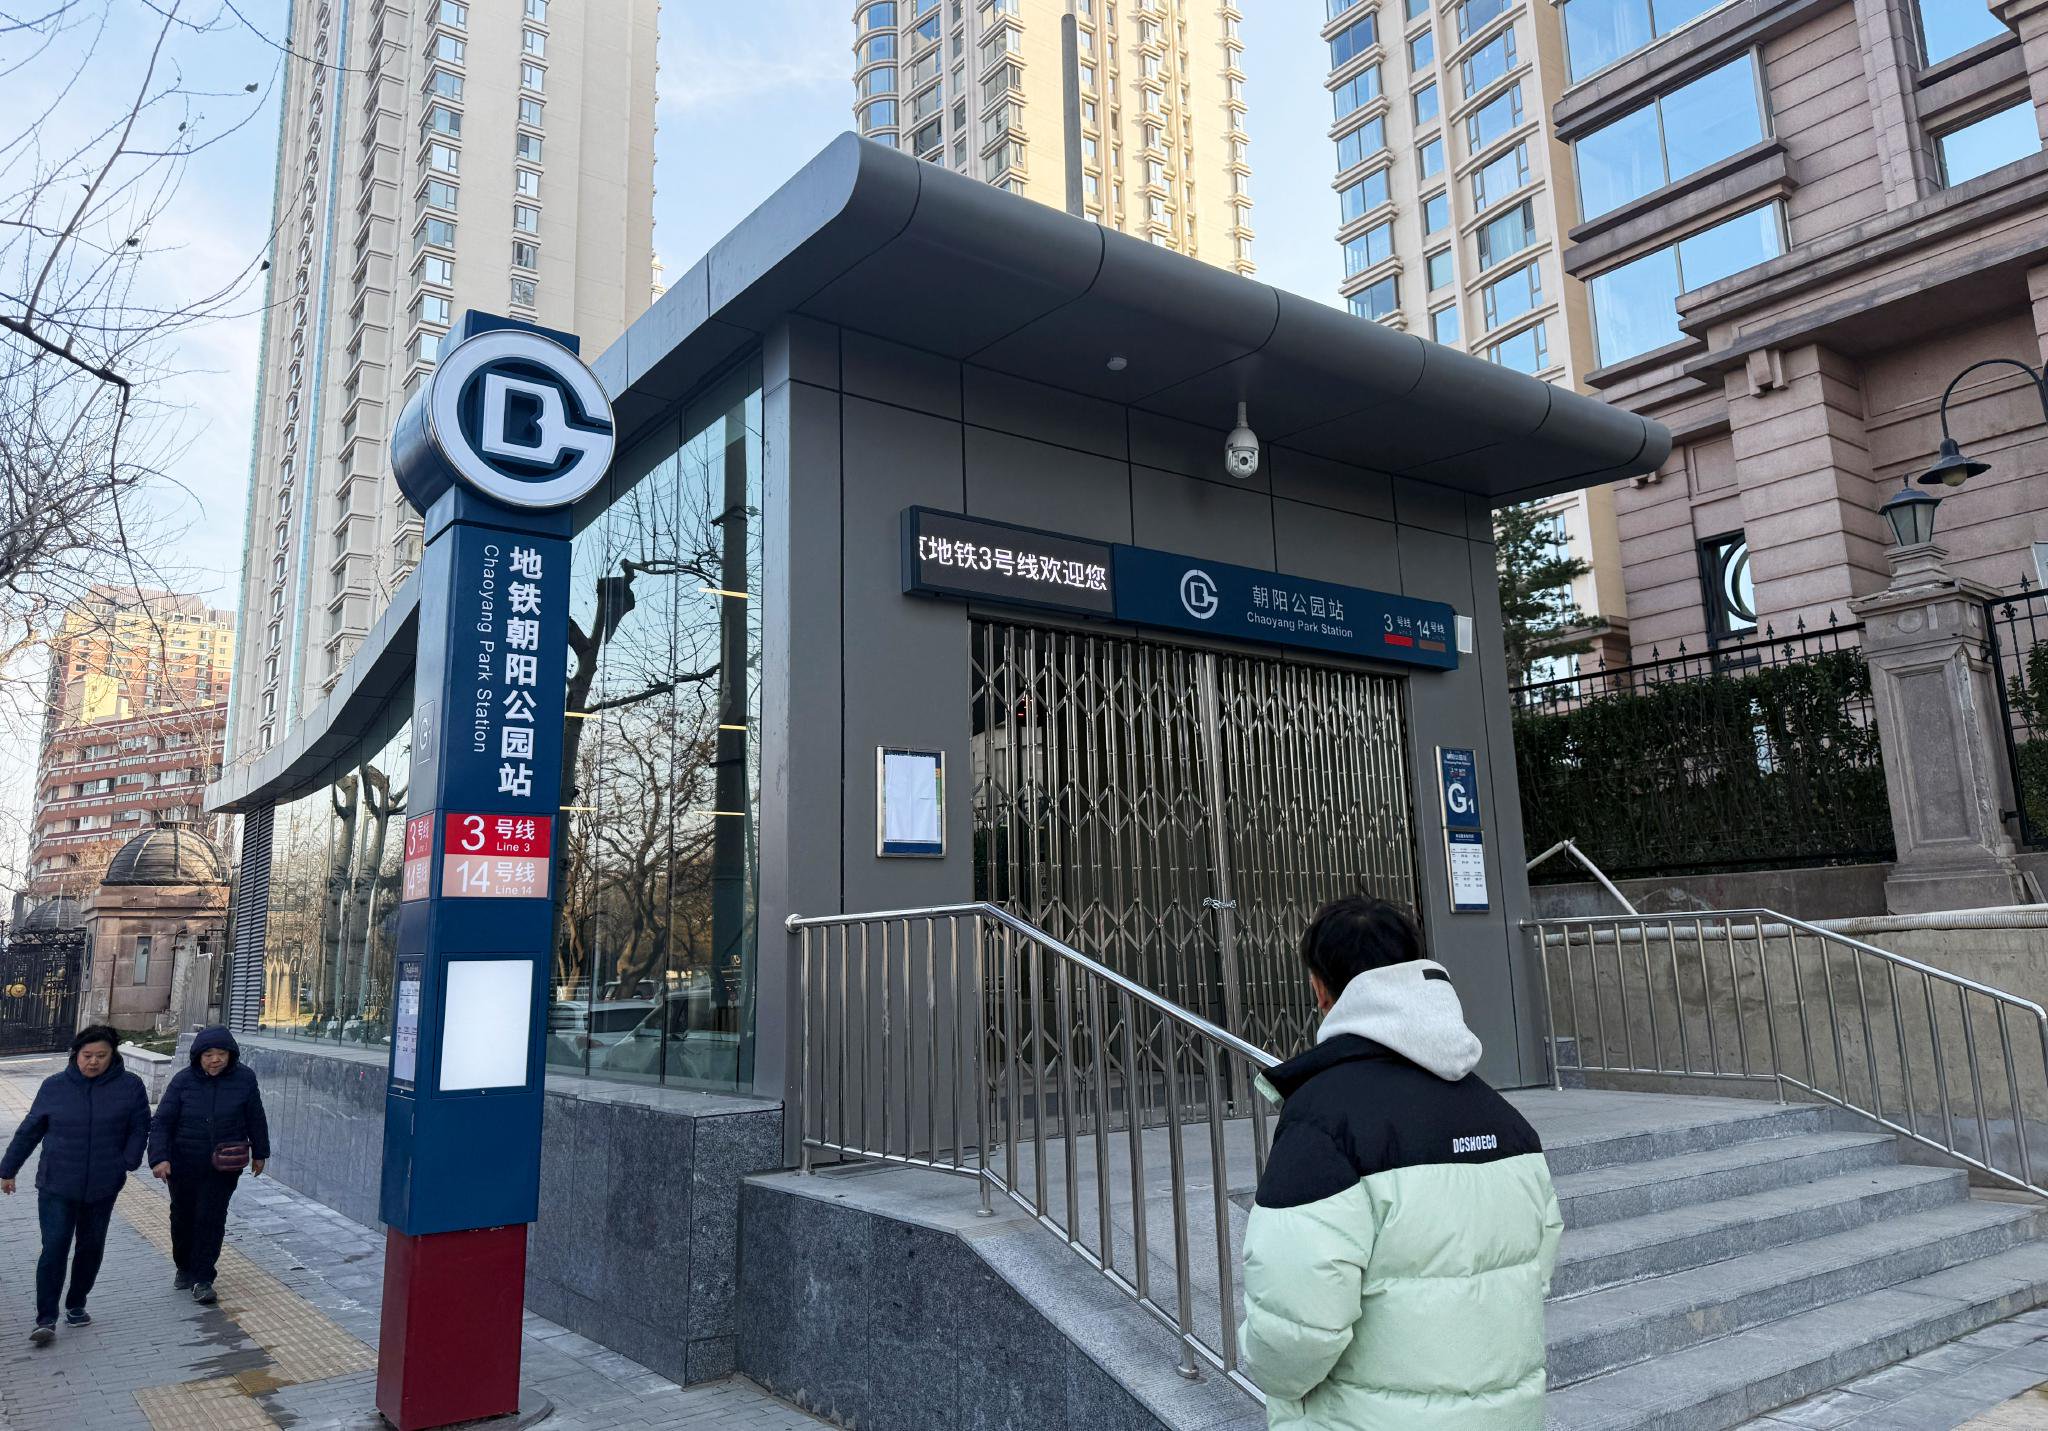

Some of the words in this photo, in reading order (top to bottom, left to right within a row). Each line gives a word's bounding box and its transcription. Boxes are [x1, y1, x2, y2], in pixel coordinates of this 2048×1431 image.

[477, 544, 499, 633] Chaoyang
[1252, 585, 1344, 621] 朝阳公园站
[1246, 611, 1295, 631] Chaoyang
[1297, 619, 1318, 633] Park
[1321, 623, 1353, 638] Station
[1383, 613, 1393, 632] 3
[1416, 619, 1430, 638] 14
[478, 640, 495, 681] Park
[498, 545, 543, 798] 地铁朝阳公园站
[474, 688, 492, 753] Station
[461, 815, 486, 851] 3
[495, 818, 535, 841] 号线
[496, 841, 519, 852] Line
[523, 842, 531, 852] 3
[456, 860, 491, 893] 14
[494, 861, 536, 883] 号线
[495, 885, 519, 895] Line
[521, 886, 532, 895] 14
